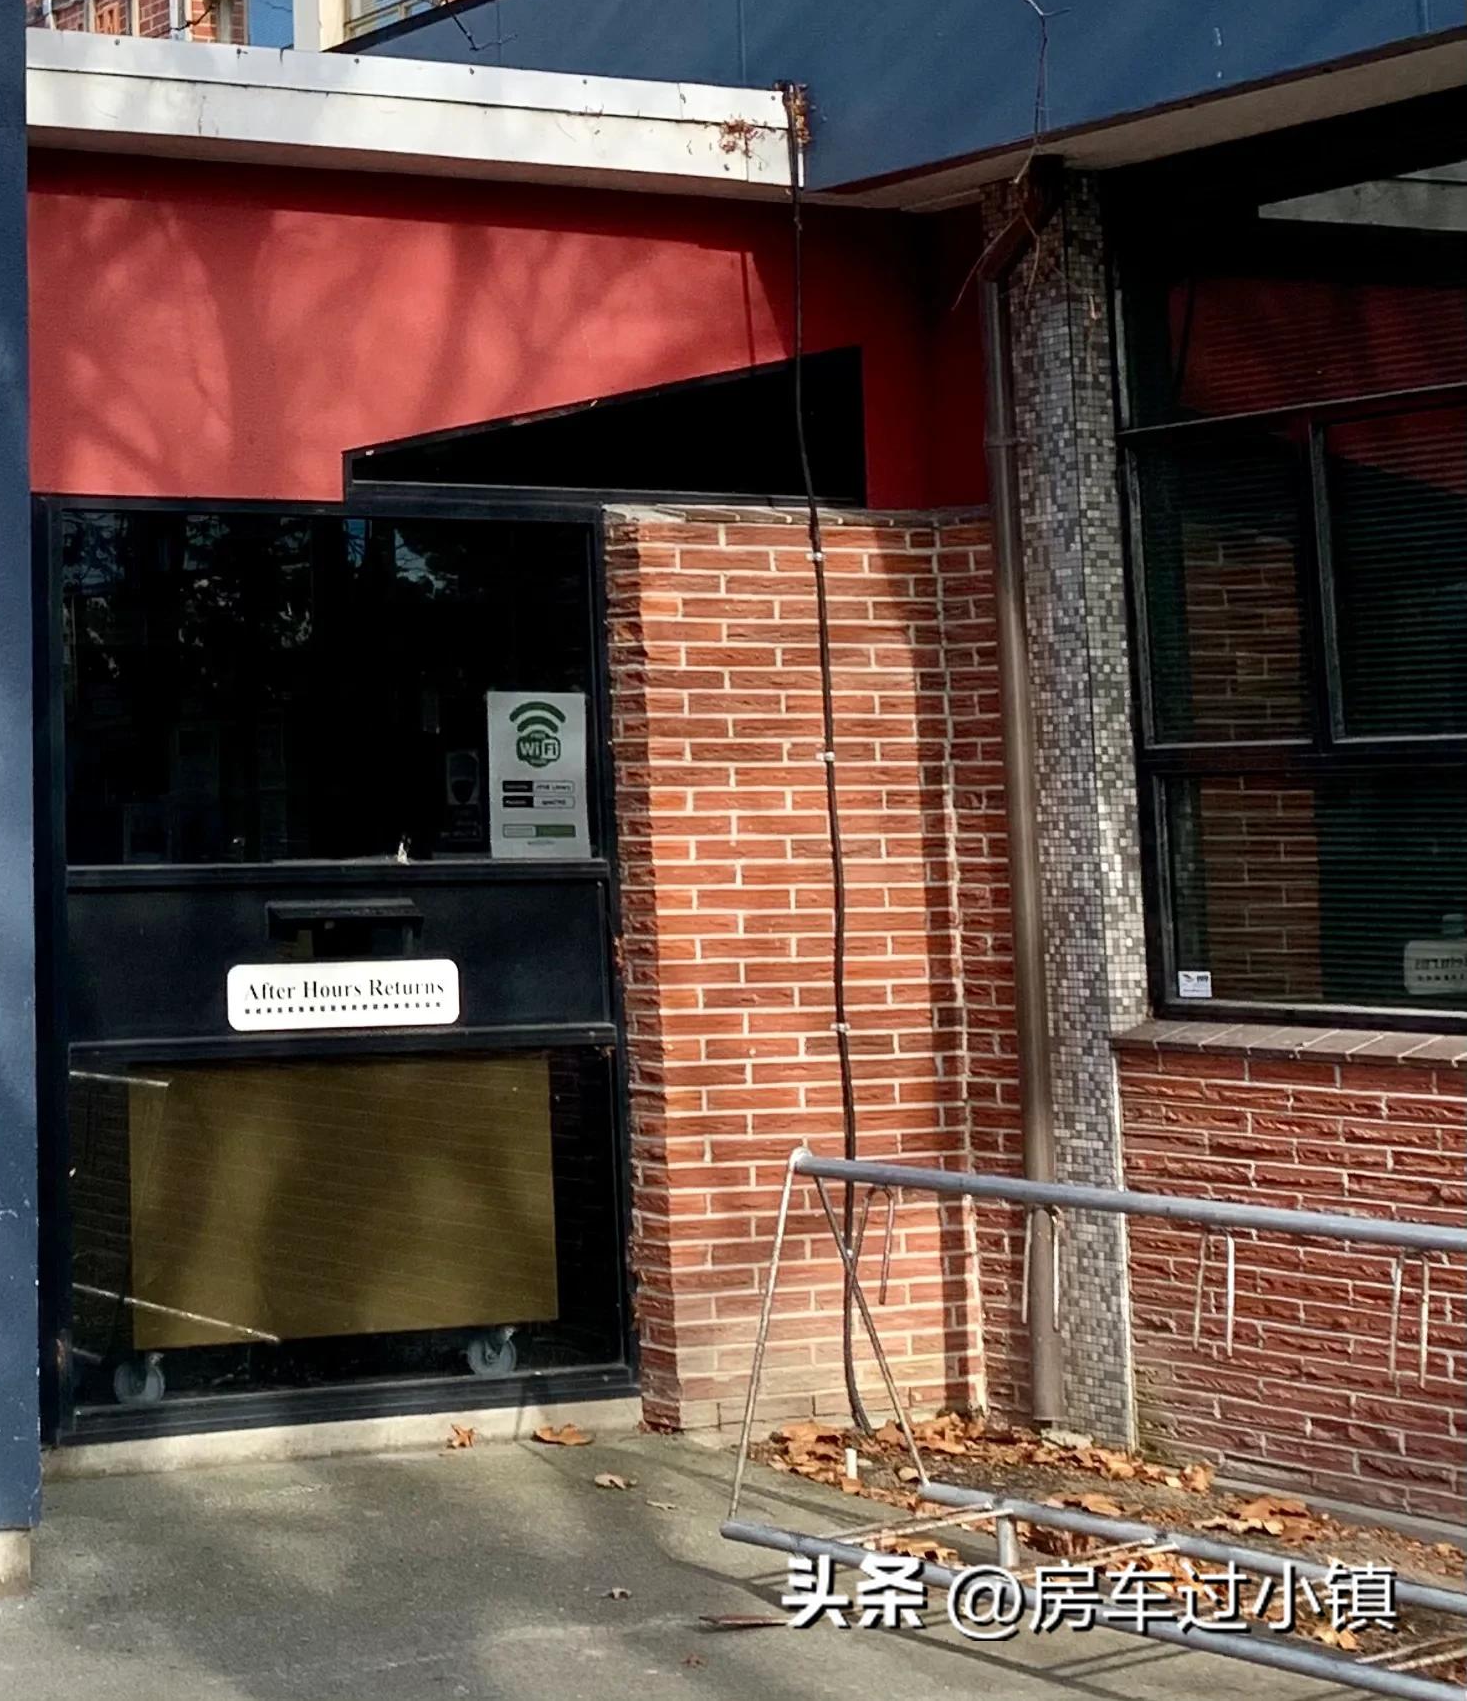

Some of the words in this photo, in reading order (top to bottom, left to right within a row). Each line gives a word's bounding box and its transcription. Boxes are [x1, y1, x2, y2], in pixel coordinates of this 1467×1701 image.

[245, 982, 296, 1001] After
[303, 980, 362, 999] Hours
[369, 978, 445, 996] Returns
